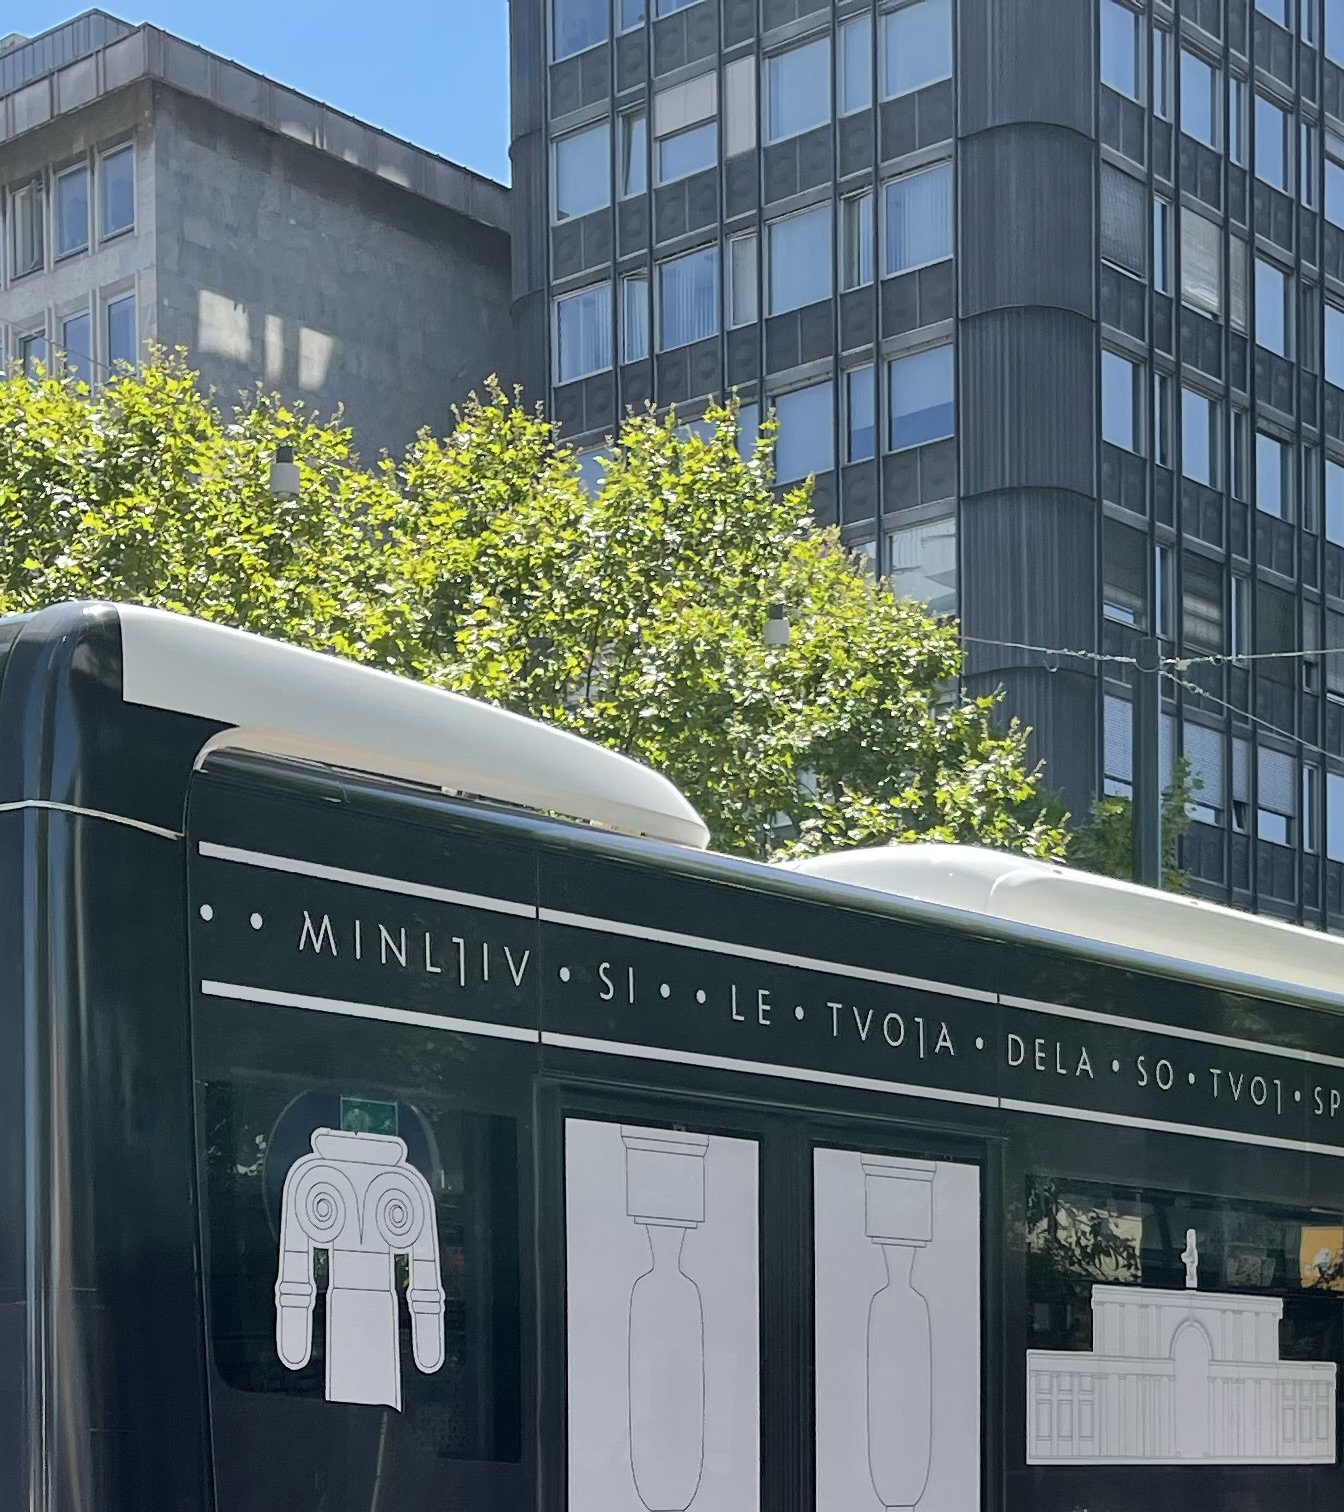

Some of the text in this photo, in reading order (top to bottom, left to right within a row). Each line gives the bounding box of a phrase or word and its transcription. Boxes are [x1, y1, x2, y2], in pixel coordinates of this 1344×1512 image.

[599, 962, 635, 1004] SI
[730, 983, 771, 1027] LE
[826, 1001, 955, 1060] TVOJA
[1006, 1032, 1094, 1080] DELA
[1136, 1055, 1174, 1091] SO
[1210, 1068, 1283, 1115] TVOJ
